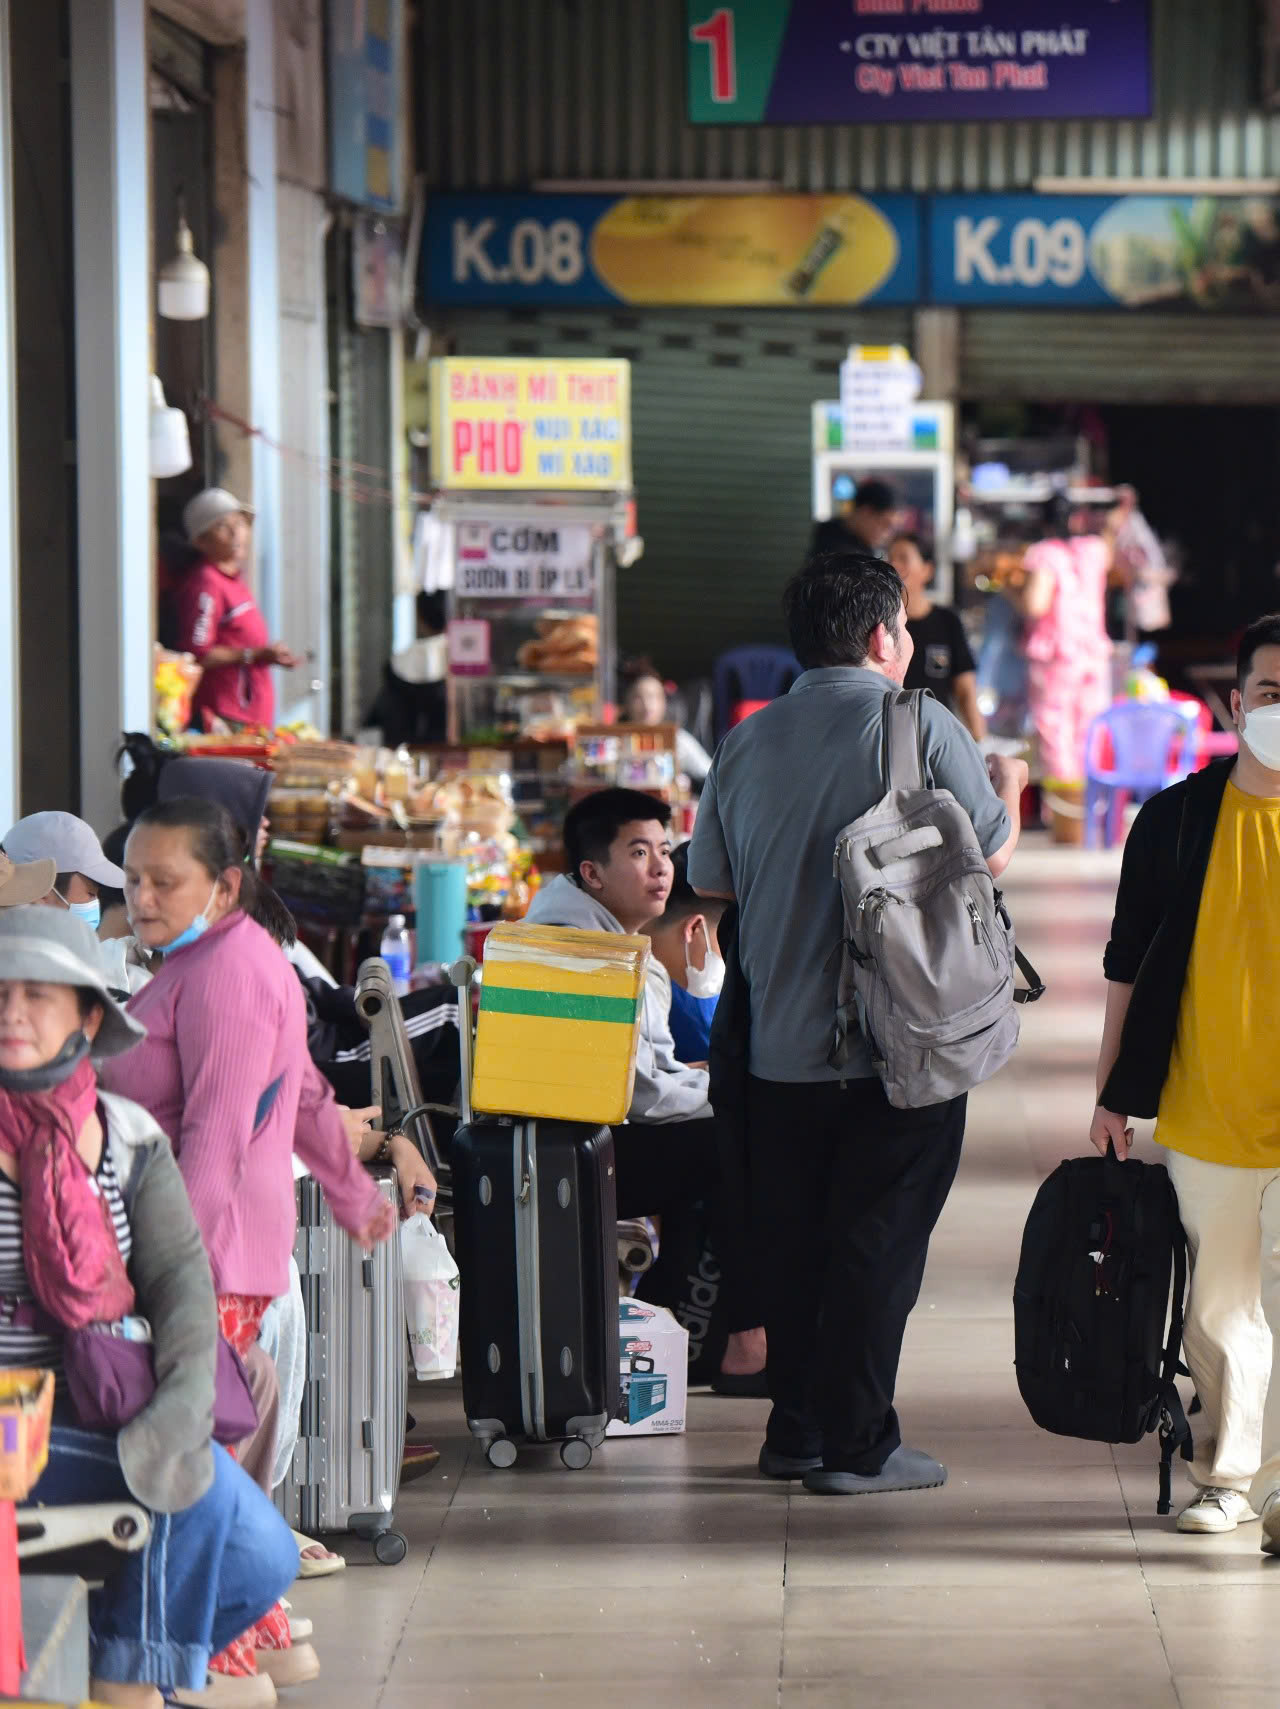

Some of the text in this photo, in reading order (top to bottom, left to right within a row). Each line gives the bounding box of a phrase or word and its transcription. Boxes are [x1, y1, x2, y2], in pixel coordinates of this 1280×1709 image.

[691, 9, 735, 103] 1
[854, 32, 900, 59] CTY
[452, 219, 583, 285] K.08
[954, 216, 1087, 287] K.09
[450, 371, 518, 403] BÁNH
